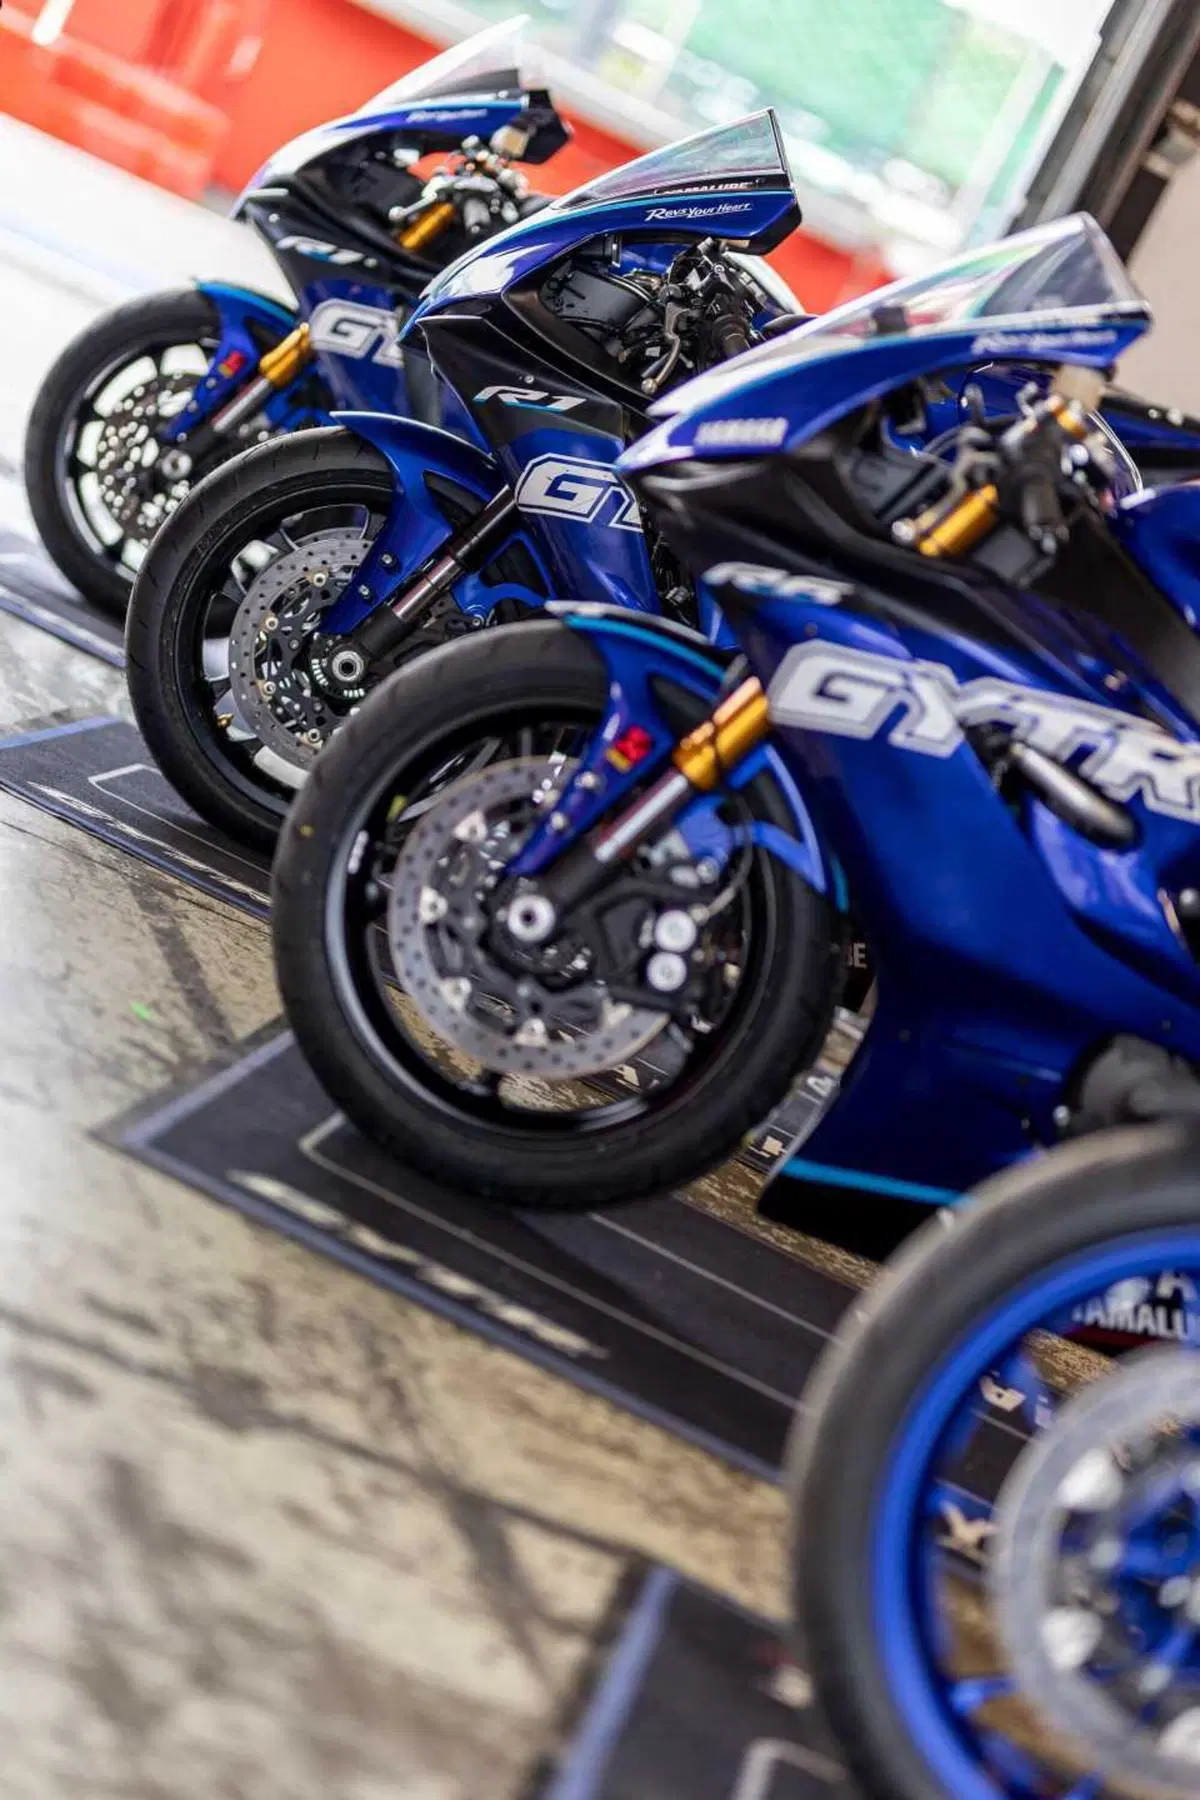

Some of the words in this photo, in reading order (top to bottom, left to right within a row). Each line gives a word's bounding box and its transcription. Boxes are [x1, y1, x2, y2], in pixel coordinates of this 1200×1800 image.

[645, 207, 687, 221] Revs
[686, 205, 715, 218] Your
[716, 203, 752, 213] Heart
[473, 386, 587, 412] R1
